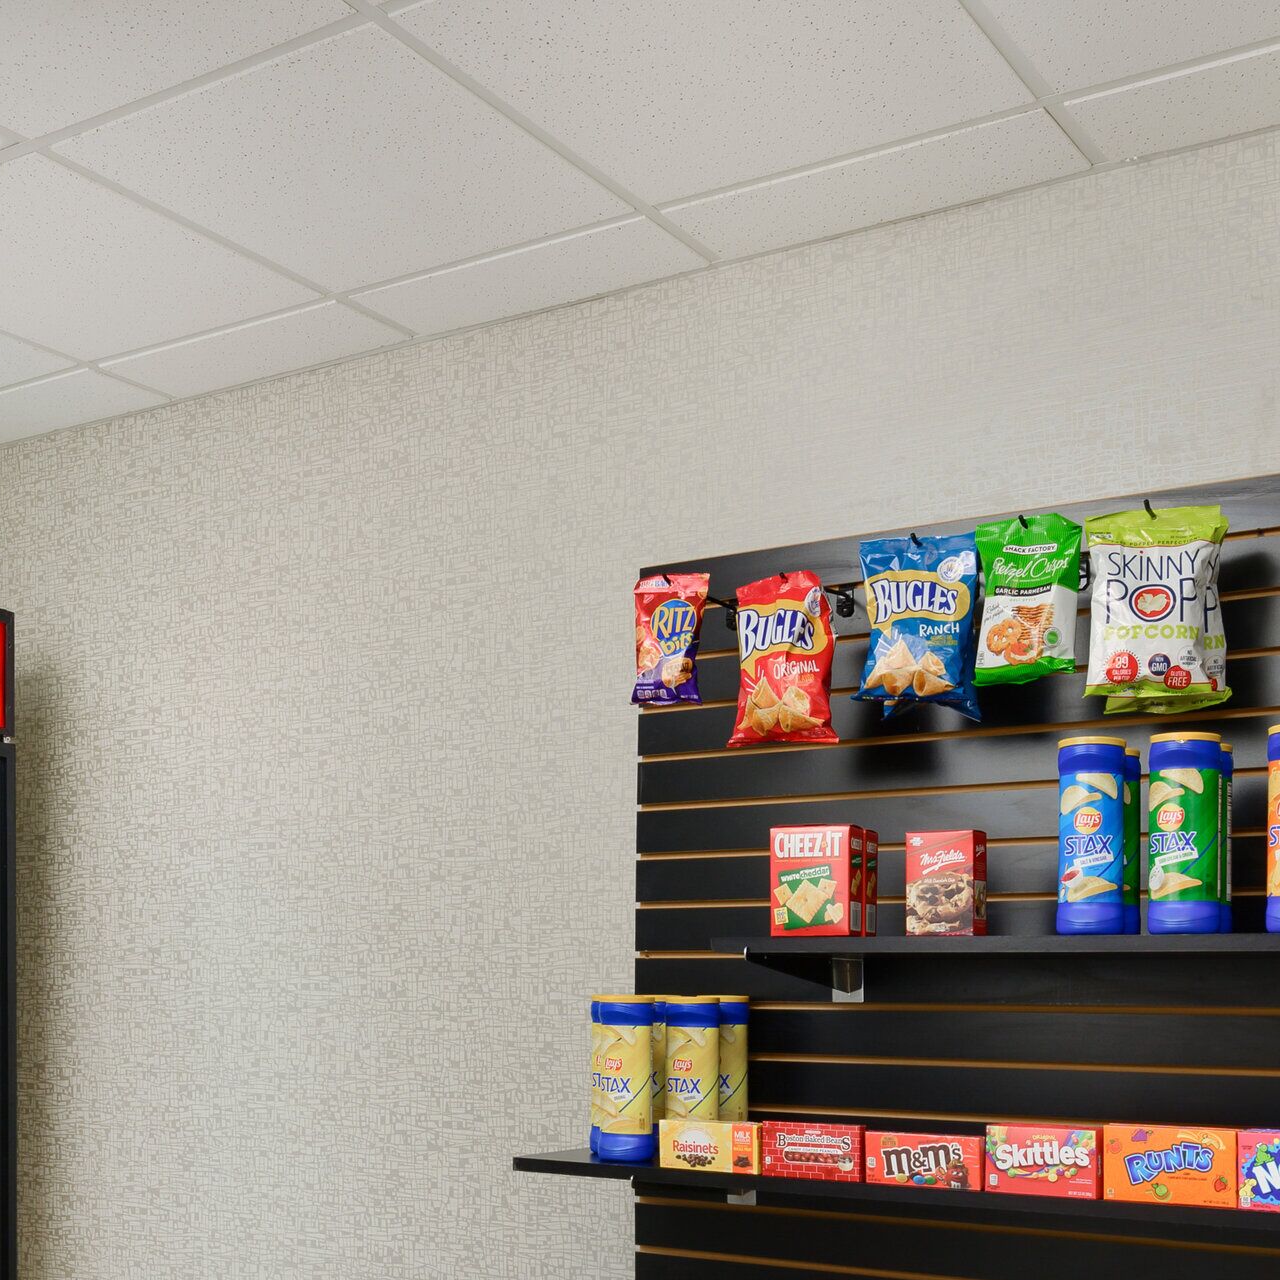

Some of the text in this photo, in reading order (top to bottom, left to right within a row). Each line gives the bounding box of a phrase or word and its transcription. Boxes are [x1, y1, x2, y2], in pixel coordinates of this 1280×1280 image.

[1027, 544, 1056, 553] FACTORY
[993, 556, 1069, 584] Pretzel Crisps
[1107, 549, 1200, 581] SKINNY
[995, 585, 1052, 595] GARLIC PARMESAN
[871, 578, 958, 625] BUGLES
[1106, 577, 1198, 624] POP
[653, 606, 697, 640] RITZ
[919, 623, 959, 636] RANCH
[738, 608, 815, 662] BUGLES
[1104, 624, 1199, 641] POPCORN
[660, 632, 693, 656] bits
[773, 660, 819, 679] ORIGINAL
[1115, 656, 1128, 668] 99
[1151, 662, 1167, 671] GMO
[1167, 677, 1187, 687] FREE
[1076, 811, 1102, 827] Lay's
[1159, 809, 1184, 825] Lay's
[1065, 835, 1114, 855] STAX
[1151, 832, 1197, 853] STAX
[936, 849, 966, 866] Fields
[781, 865, 829, 882] WHITE cheddar
[605, 1057, 623, 1072] Lay's
[673, 1059, 693, 1072] Lay's
[601, 1077, 631, 1094] STAX
[668, 1078, 701, 1094] STAX
[734, 1130, 751, 1139] MILK
[777, 1133, 804, 1147] Boston
[672, 1140, 719, 1155] Raisinets
[995, 1140, 1091, 1171] Skittles
[882, 1143, 962, 1178] m&m's
[1125, 1142, 1215, 1185] RUNTS
